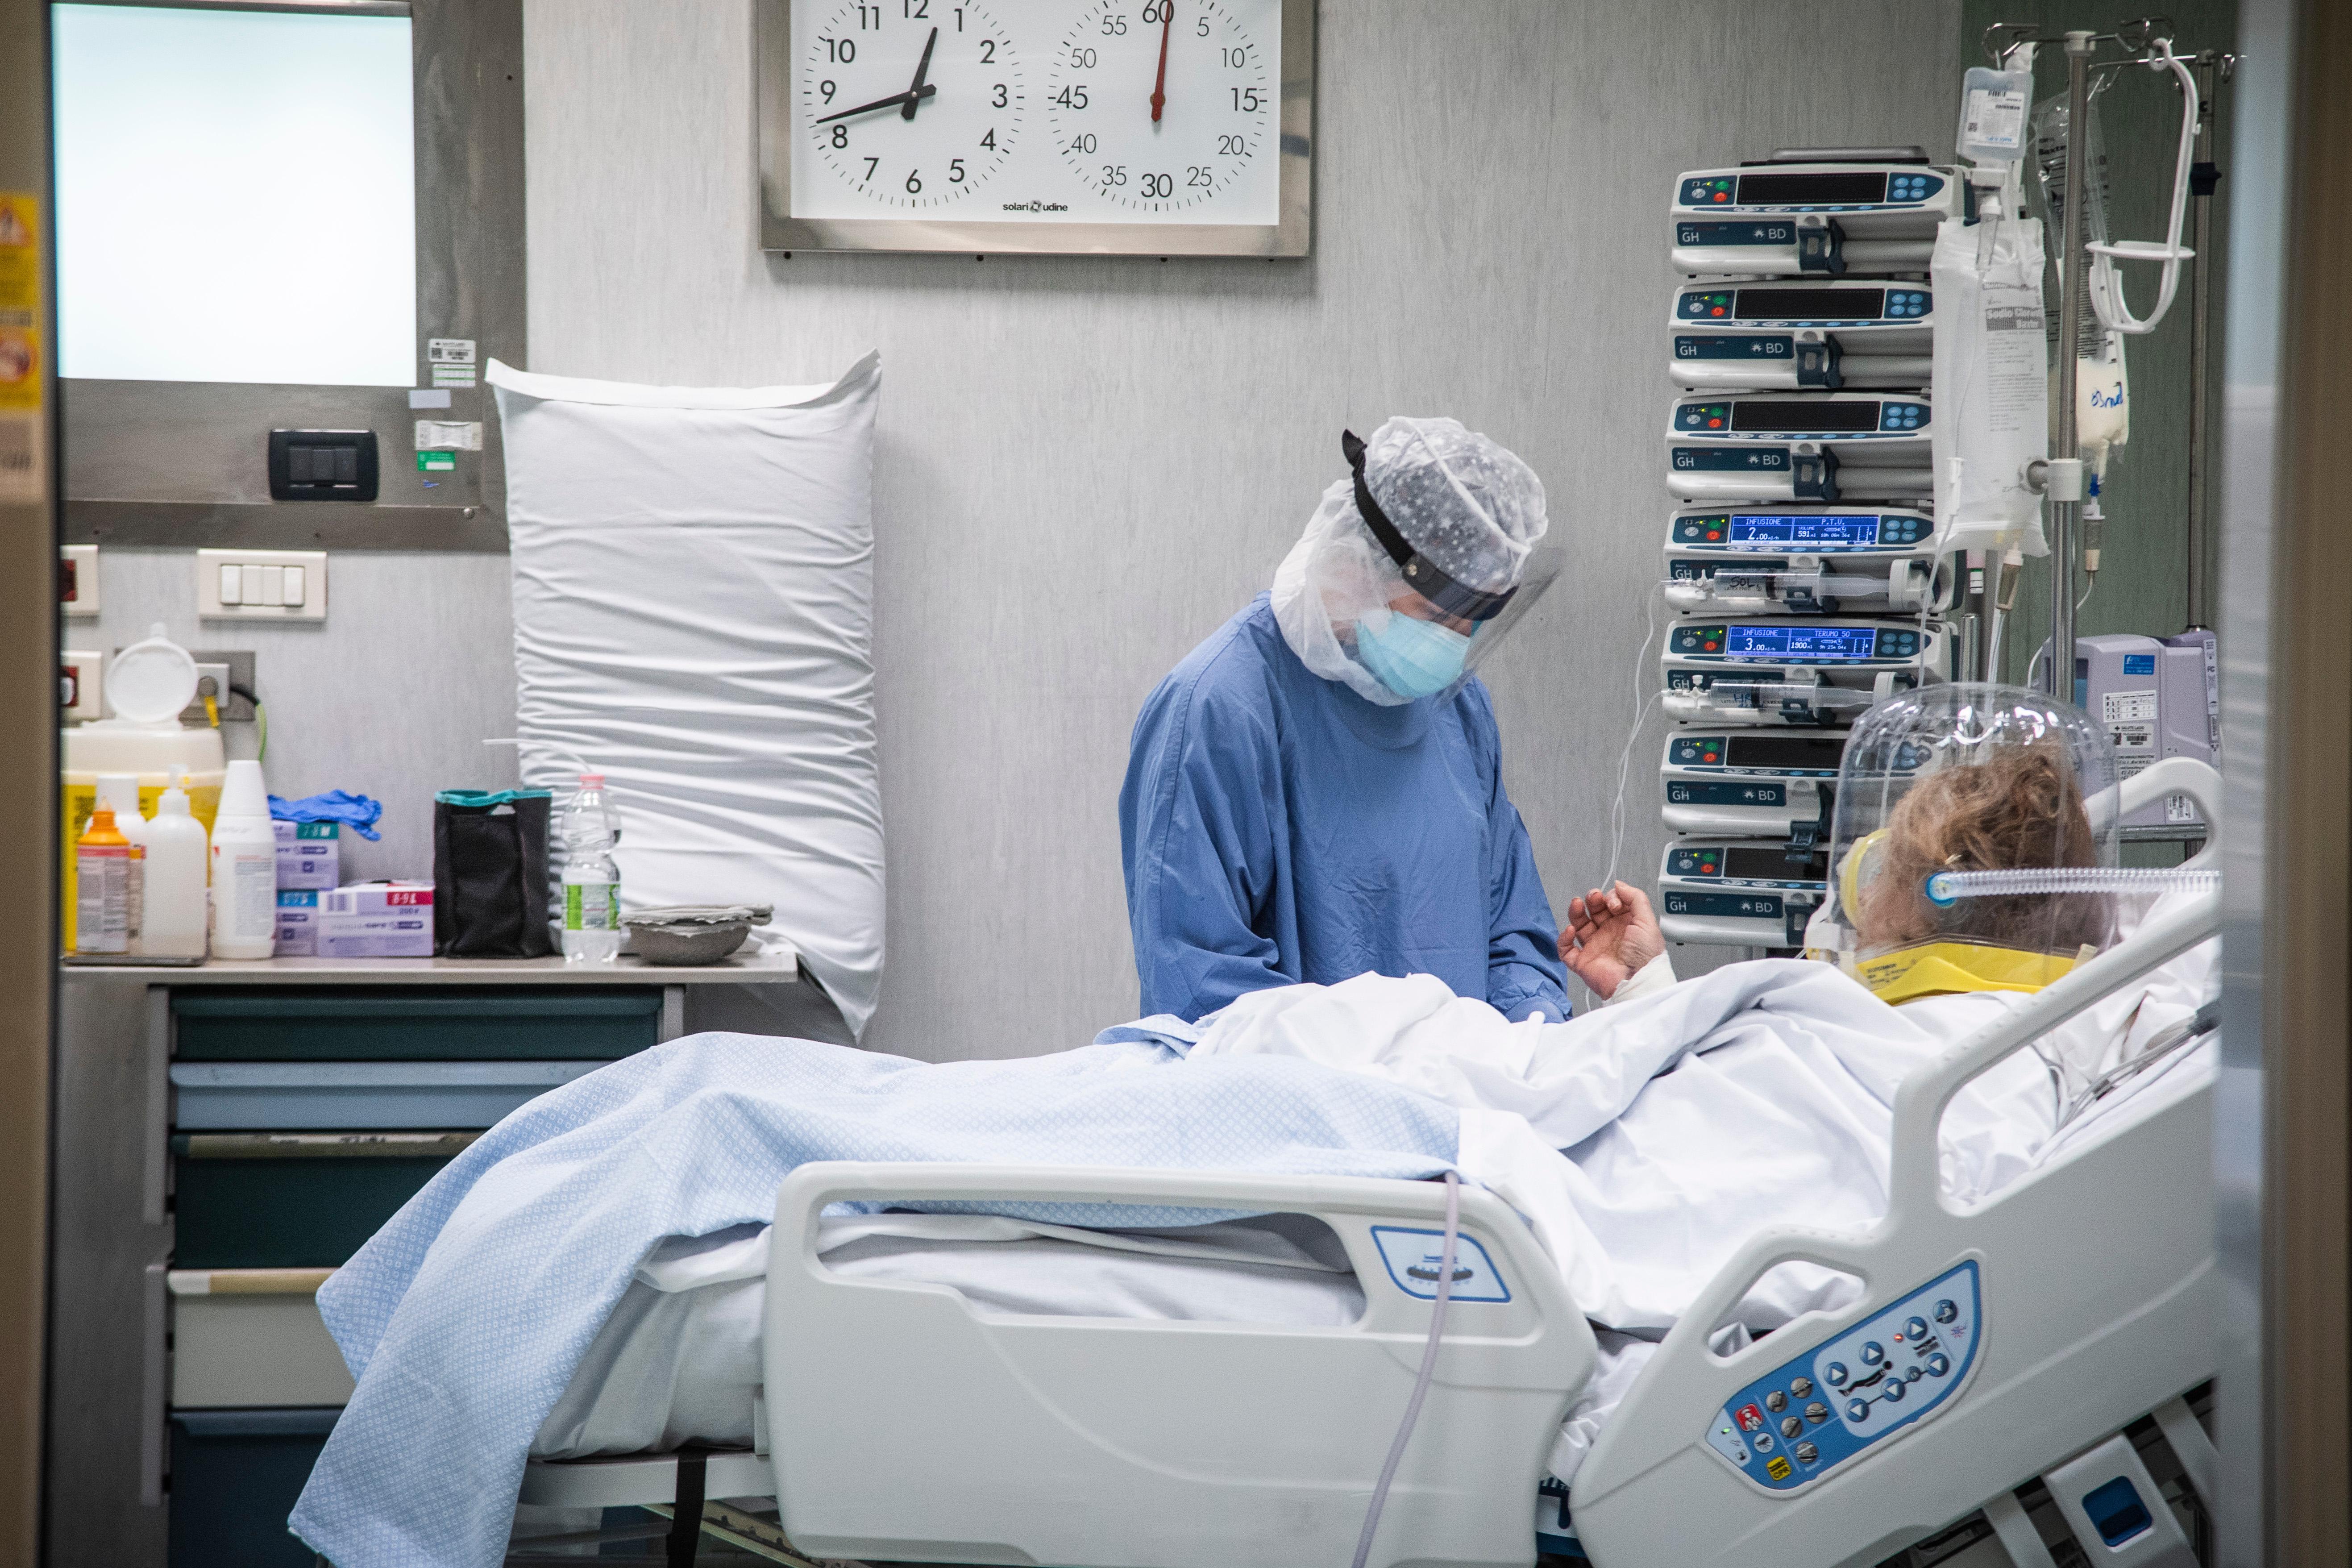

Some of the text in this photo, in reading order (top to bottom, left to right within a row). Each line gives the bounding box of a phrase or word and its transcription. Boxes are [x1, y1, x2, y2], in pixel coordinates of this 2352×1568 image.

[857, 5, 880, 31] 11
[903, 0, 929, 19] 12
[954, 8, 963, 33] 1
[1141, 0, 1175, 25] 60
[1101, 14, 1128, 36] 55
[1196, 16, 1210, 37] 5
[826, 38, 856, 64] 10
[979, 39, 995, 64] 2
[1070, 47, 1097, 69] 50
[1221, 47, 1245, 69] 10
[820, 79, 837, 105] 9
[991, 83, 1009, 109] 3
[1055, 84, 1089, 110] 45
[1230, 87, 1259, 112] 15
[831, 124, 849, 150] 8
[979, 127, 997, 152] 4
[1070, 133, 1097, 154] 40
[1218, 135, 1245, 156] 20
[863, 156, 880, 182] 7
[948, 158, 966, 183] 5
[1101, 165, 1127, 187] 35
[1186, 166, 1213, 187] 25
[905, 169, 923, 194] 6
[1140, 173, 1174, 199] 30
[1003, 203, 1068, 211] solari udine
[1682, 232, 1699, 242] GH
[1768, 228, 1787, 239] BD
[1679, 345, 1697, 356] GH
[1766, 342, 1784, 354] BD
[1676, 456, 1694, 467] GH
[1762, 454, 1781, 466] BD
[1675, 569, 1692, 579] GH
[1673, 679, 1690, 690] GH
[1672, 790, 1690, 801] GH
[1758, 790, 1776, 801] BD
[1670, 901, 1687, 911] GH
[1755, 902, 1773, 913] BD
